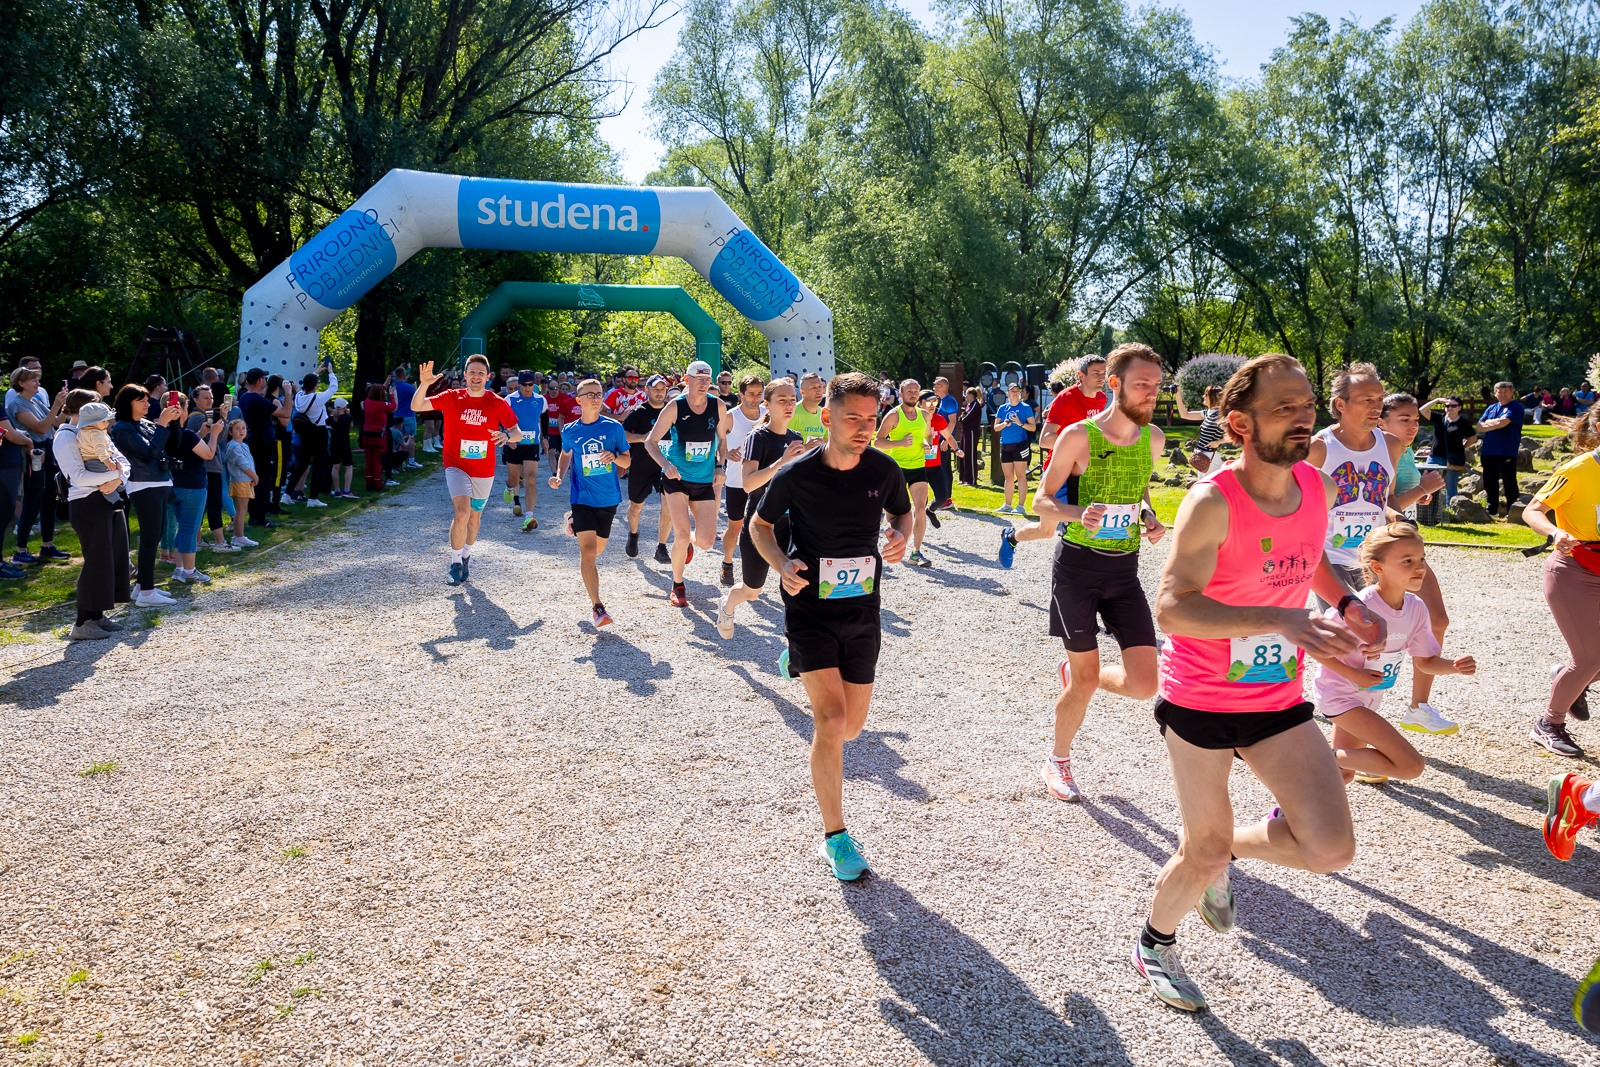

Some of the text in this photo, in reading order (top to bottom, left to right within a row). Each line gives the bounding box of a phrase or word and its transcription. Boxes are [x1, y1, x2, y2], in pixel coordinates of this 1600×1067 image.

[285, 208, 379, 290] PRIRODNO
[295, 218, 400, 311] POBJEDNICI
[726, 226, 804, 303] PRIRODNO
[708, 236, 799, 323] POBJEDNICI
[460, 413, 488, 424] MARATON
[468, 445, 480, 453] 63
[691, 447, 708, 456] 127
[1102, 513, 1131, 528] 118
[1344, 524, 1372, 538] 128
[836, 568, 860, 586] 97
[1259, 572, 1286, 583] UTRKA
[1253, 643, 1282, 666] 83
[1382, 660, 1402, 678] 86
